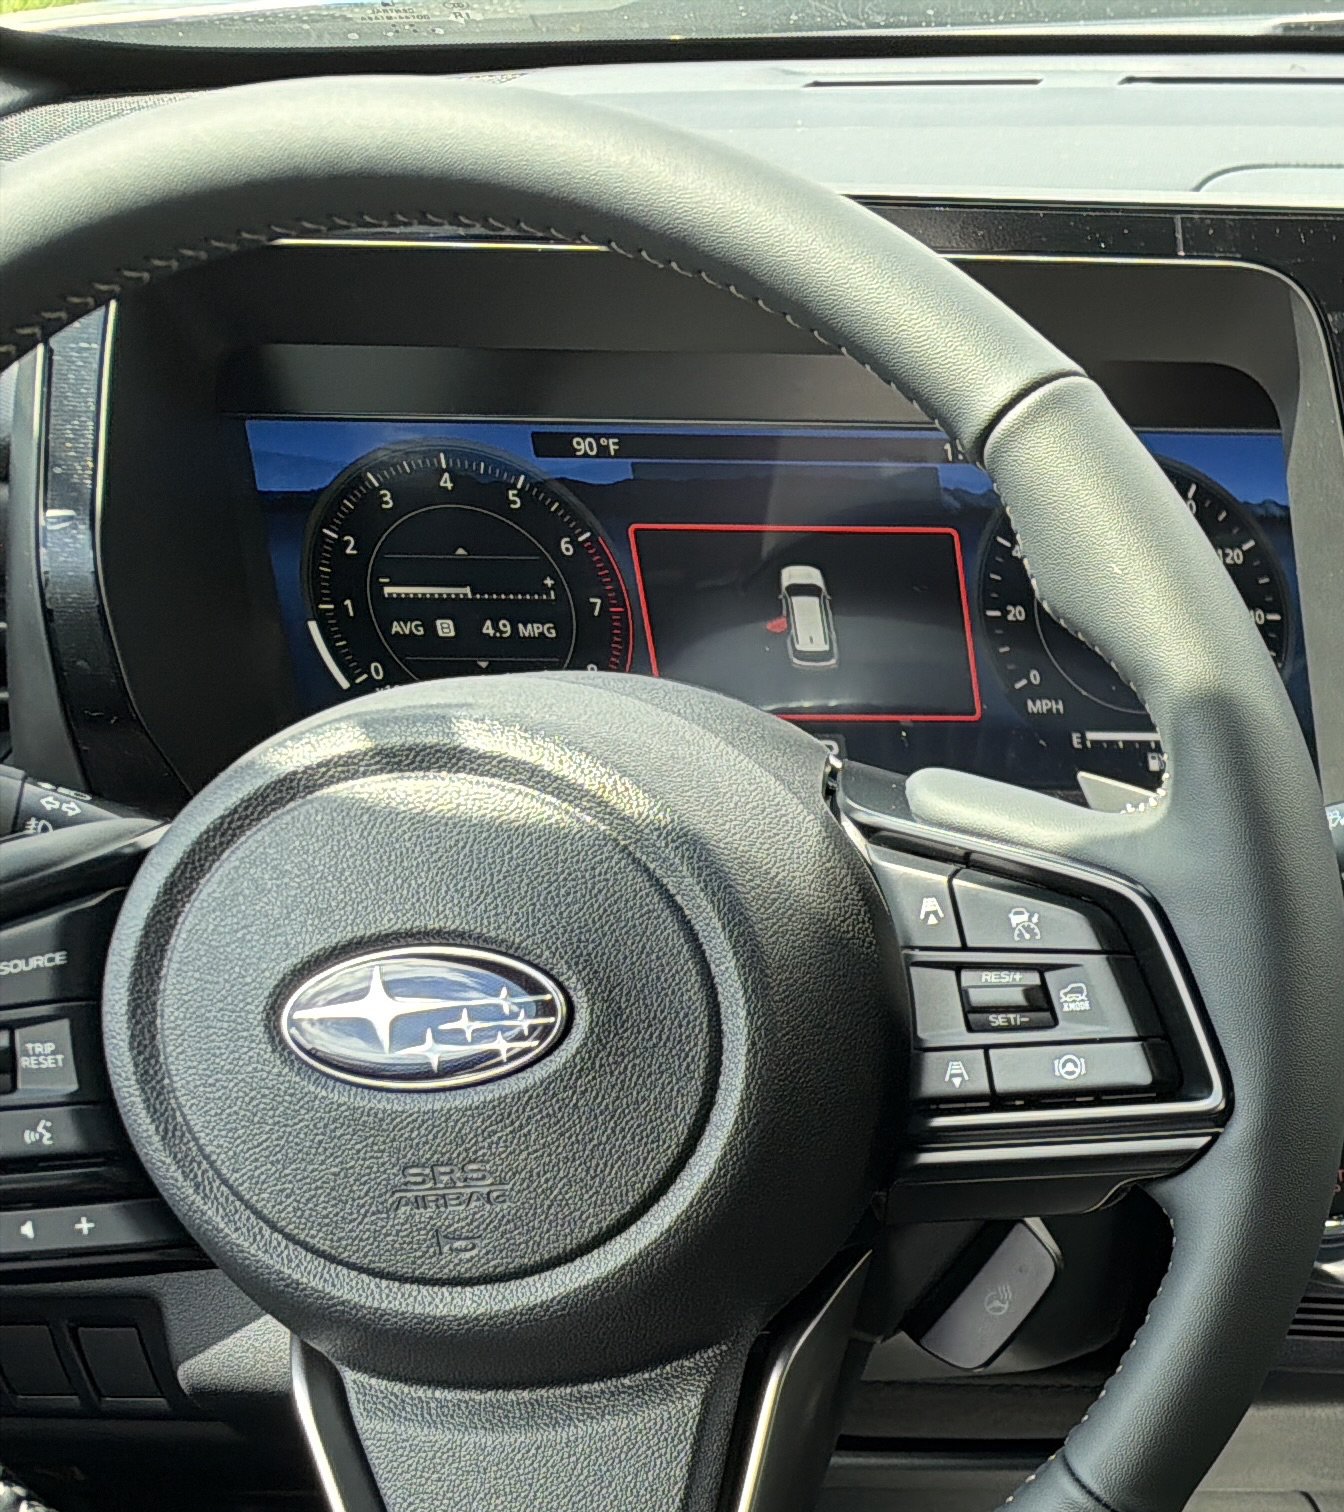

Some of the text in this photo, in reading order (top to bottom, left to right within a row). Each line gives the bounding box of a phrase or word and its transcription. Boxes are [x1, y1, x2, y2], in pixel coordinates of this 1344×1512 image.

[572, 437, 620, 456] 90°F
[439, 472, 453, 490] 4
[379, 490, 394, 509] 3
[508, 490, 521, 509] 5
[343, 536, 357, 554] 2
[560, 537, 573, 556] 6
[343, 599, 354, 617] 1
[589, 598, 602, 617] 7
[1006, 605, 1026, 621] 20
[391, 620, 424, 636] AVG
[482, 619, 512, 638] 4.9
[518, 623, 557, 638] MPG
[370, 662, 384, 680] 0
[1029, 669, 1041, 685] 0
[1026, 699, 1064, 714] MPH
[1071, 732, 1083, 749] E
[0, 950, 68, 976] SOURCE
[25, 1042, 56, 1055] TRIP
[20, 1054, 64, 1069] RESET
[401, 1160, 495, 1188] SRS
[394, 1188, 512, 1211] AIRBAG
